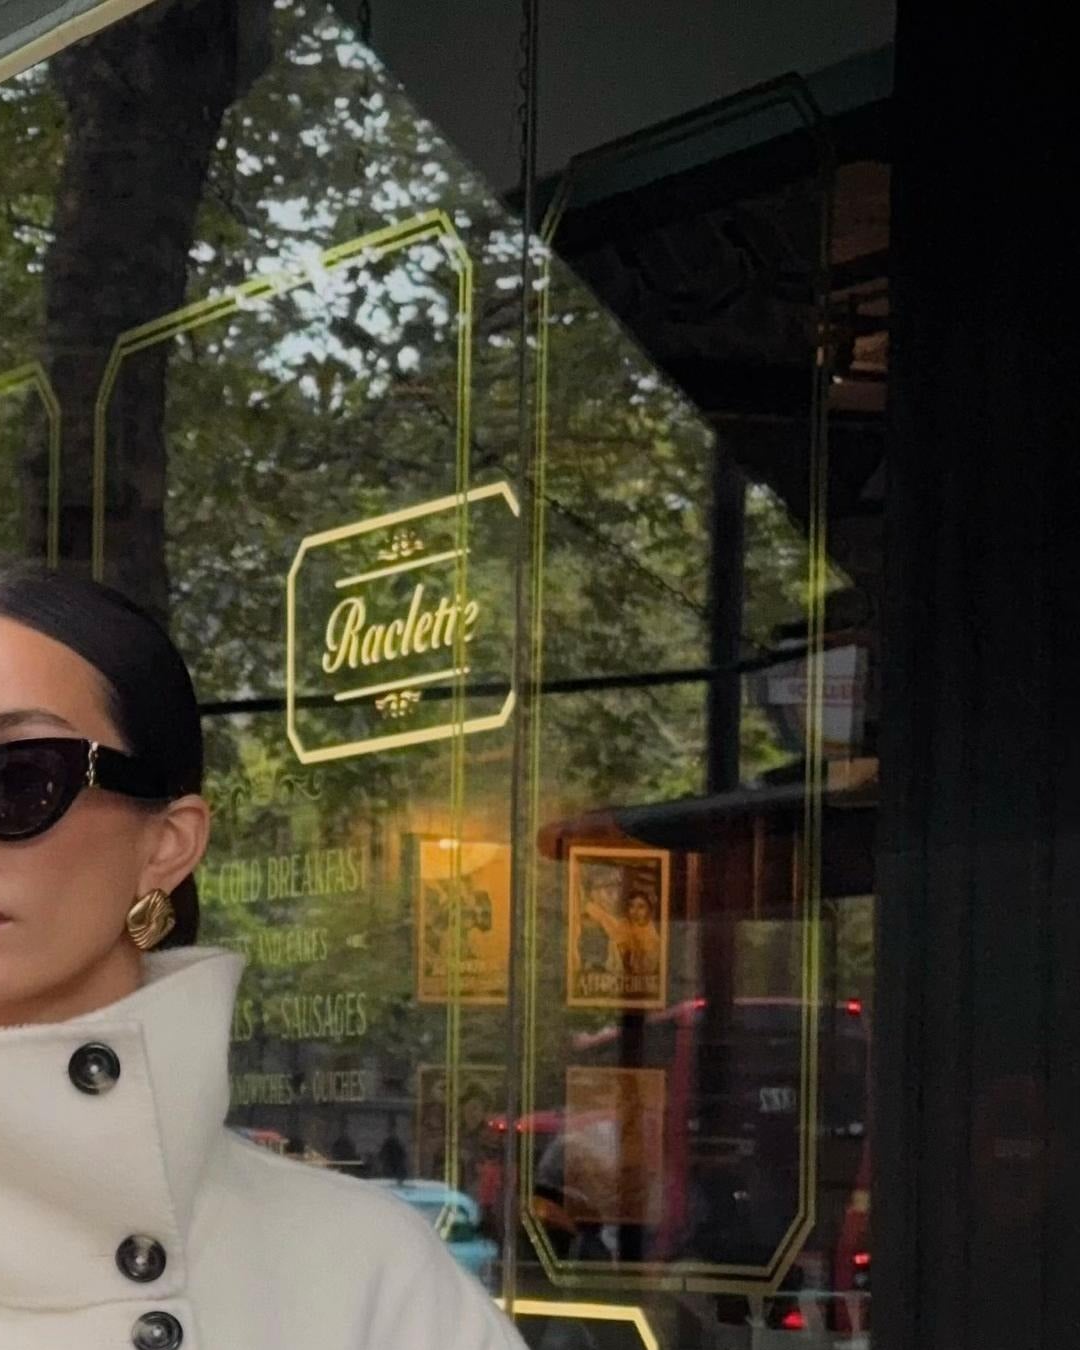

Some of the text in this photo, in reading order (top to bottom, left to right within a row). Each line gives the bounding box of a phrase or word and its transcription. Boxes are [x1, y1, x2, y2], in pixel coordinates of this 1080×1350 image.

[322, 583, 479, 674] Raclette
[266, 846, 368, 900] BREAKFAST
[280, 992, 367, 1041] SAUSAGES
